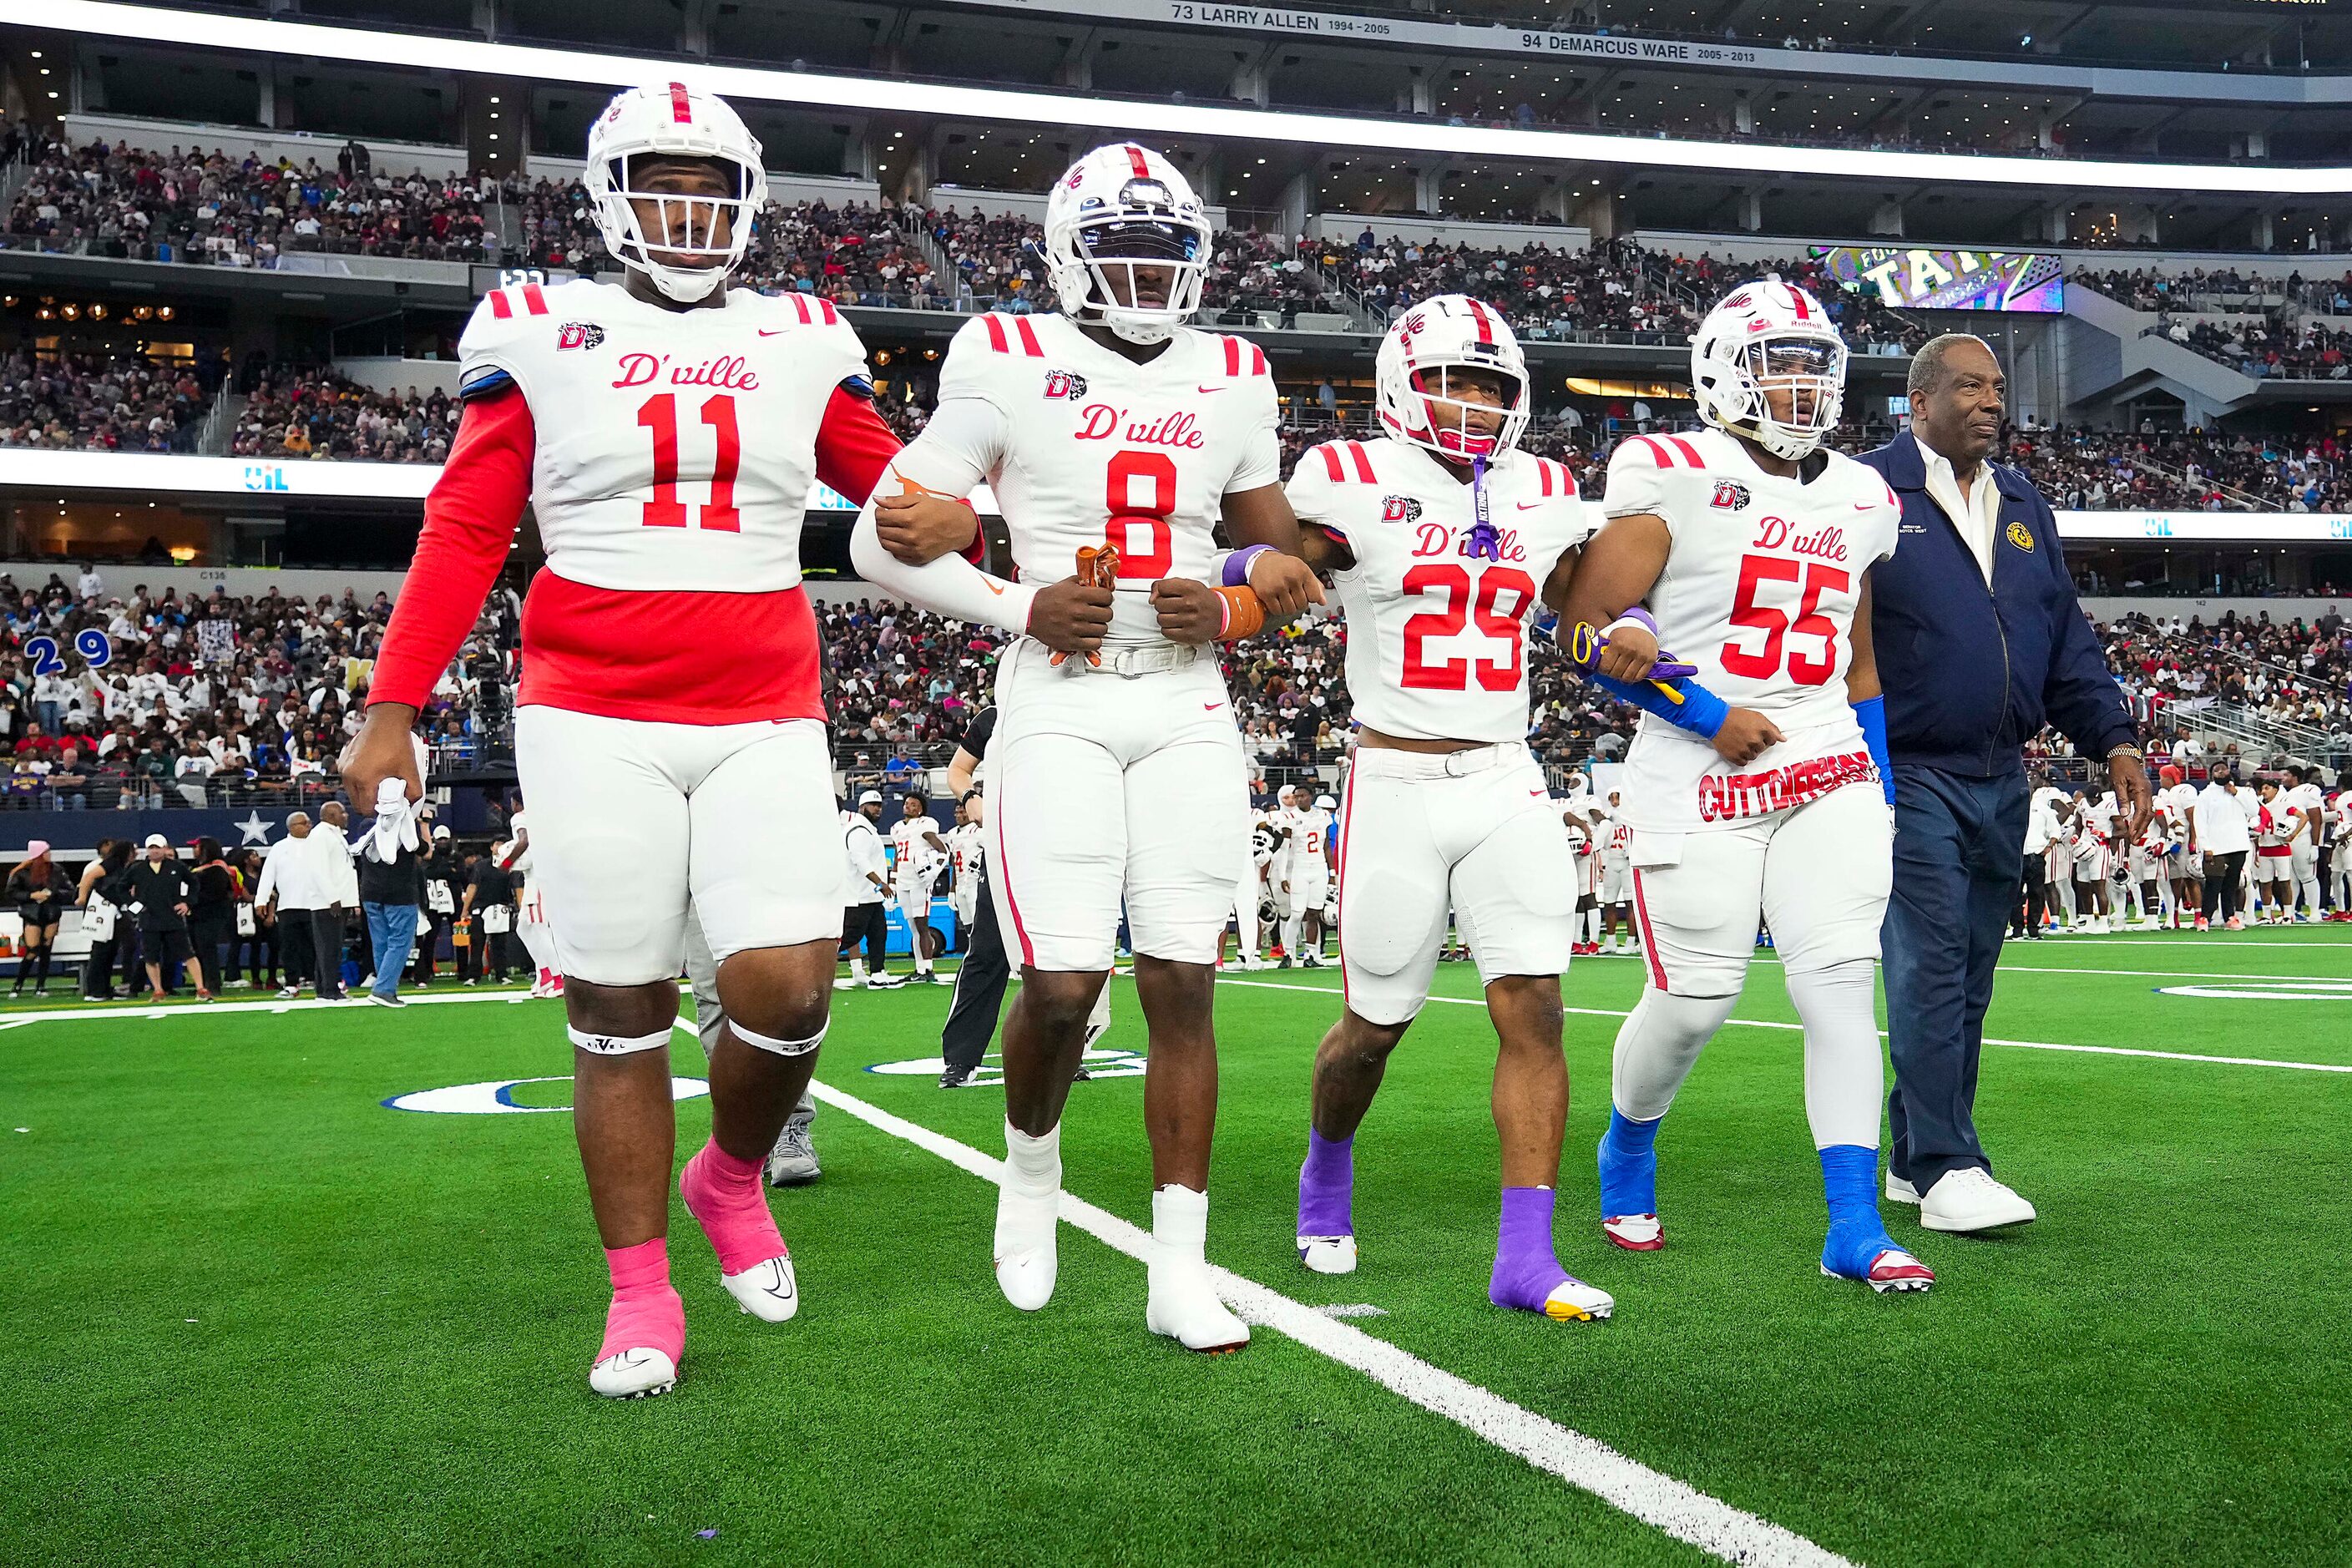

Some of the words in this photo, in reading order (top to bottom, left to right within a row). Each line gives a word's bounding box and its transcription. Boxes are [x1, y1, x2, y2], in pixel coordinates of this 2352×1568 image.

[1171, 5, 1193, 19] 73
[1201, 8, 1257, 25] LARRY
[1263, 13, 1318, 30] ALLEN
[1522, 34, 1542, 48] 94
[1642, 43, 1688, 58] WARE
[1791, 321, 1823, 329] Riddell
[612, 352, 760, 391] D'ville
[1075, 404, 1204, 450] D'ville
[637, 392, 741, 534] 11
[1105, 450, 1177, 579] 8
[1476, 492, 1490, 522] NXTRND
[1753, 516, 1849, 562] D'ville
[1400, 564, 1535, 692] 29
[1720, 554, 1850, 686] 55
[25, 636, 66, 676] 2
[76, 629, 112, 667] 9
[1307, 832, 1318, 853] 2
